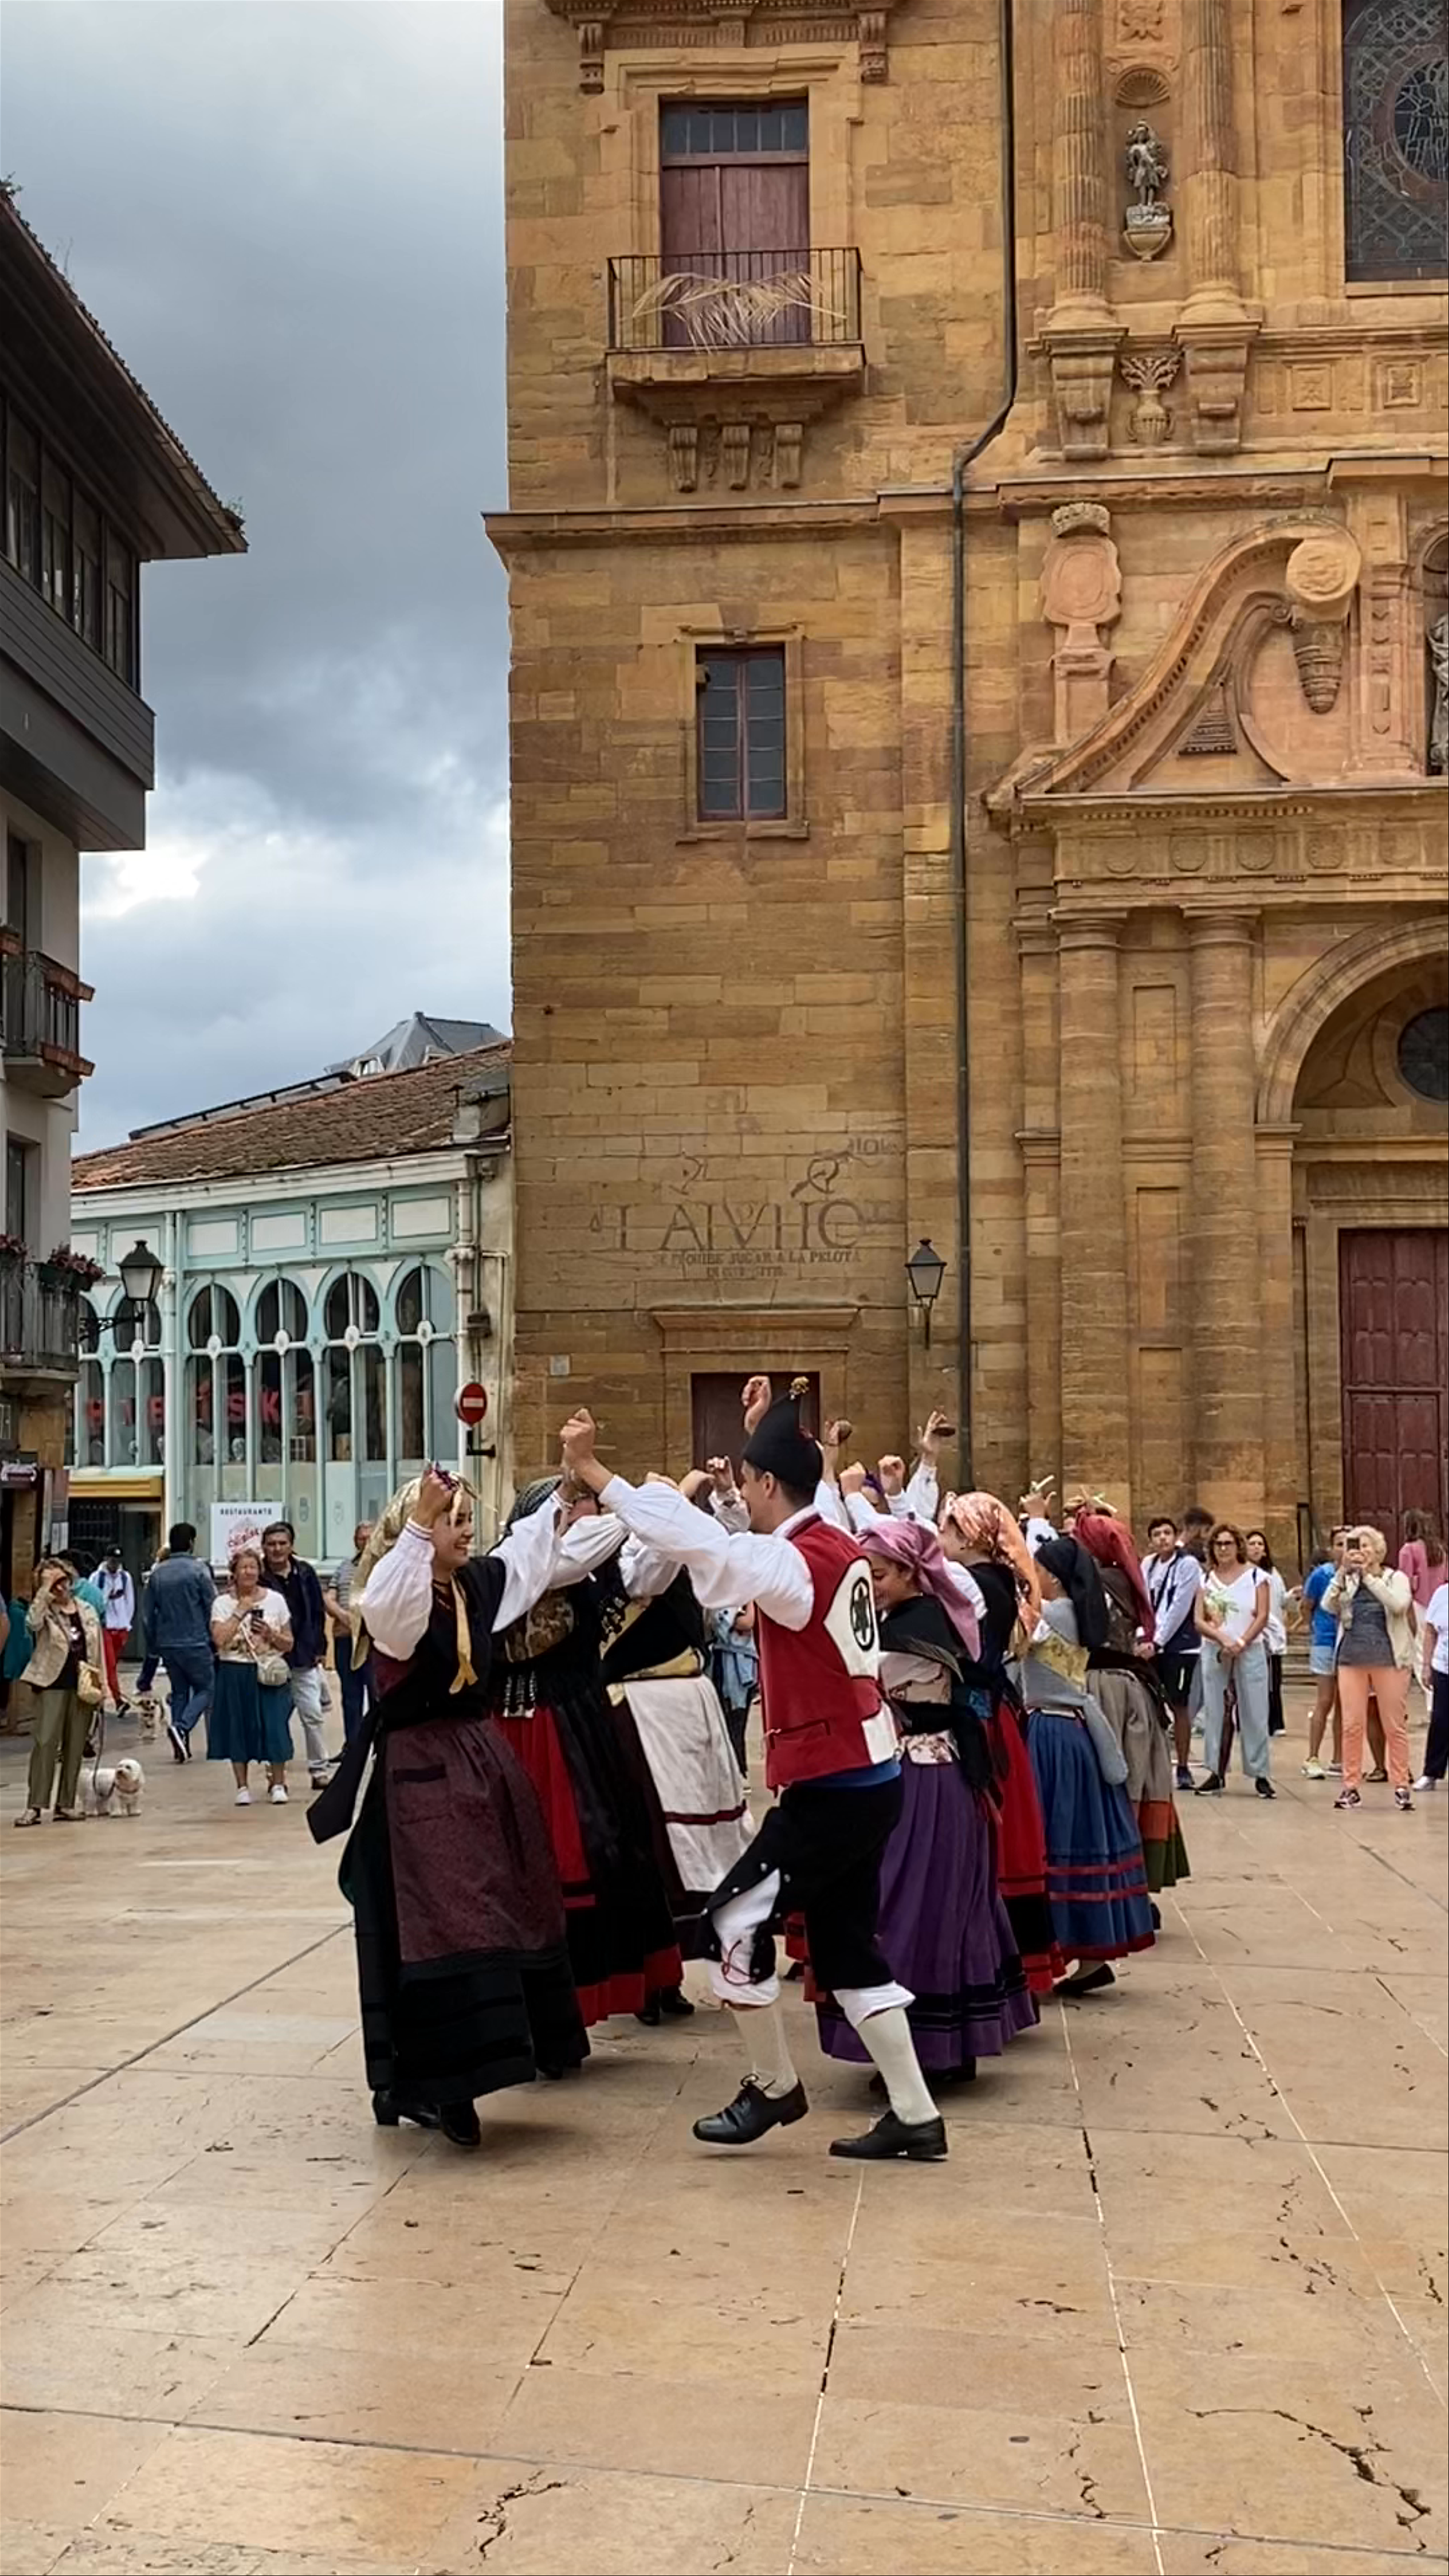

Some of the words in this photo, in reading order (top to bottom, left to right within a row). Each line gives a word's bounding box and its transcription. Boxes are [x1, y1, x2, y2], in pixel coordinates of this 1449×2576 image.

[776, 1252, 785, 1263] A
[789, 1251, 805, 1263] LA
[809, 1250, 862, 1263] PELOTA
